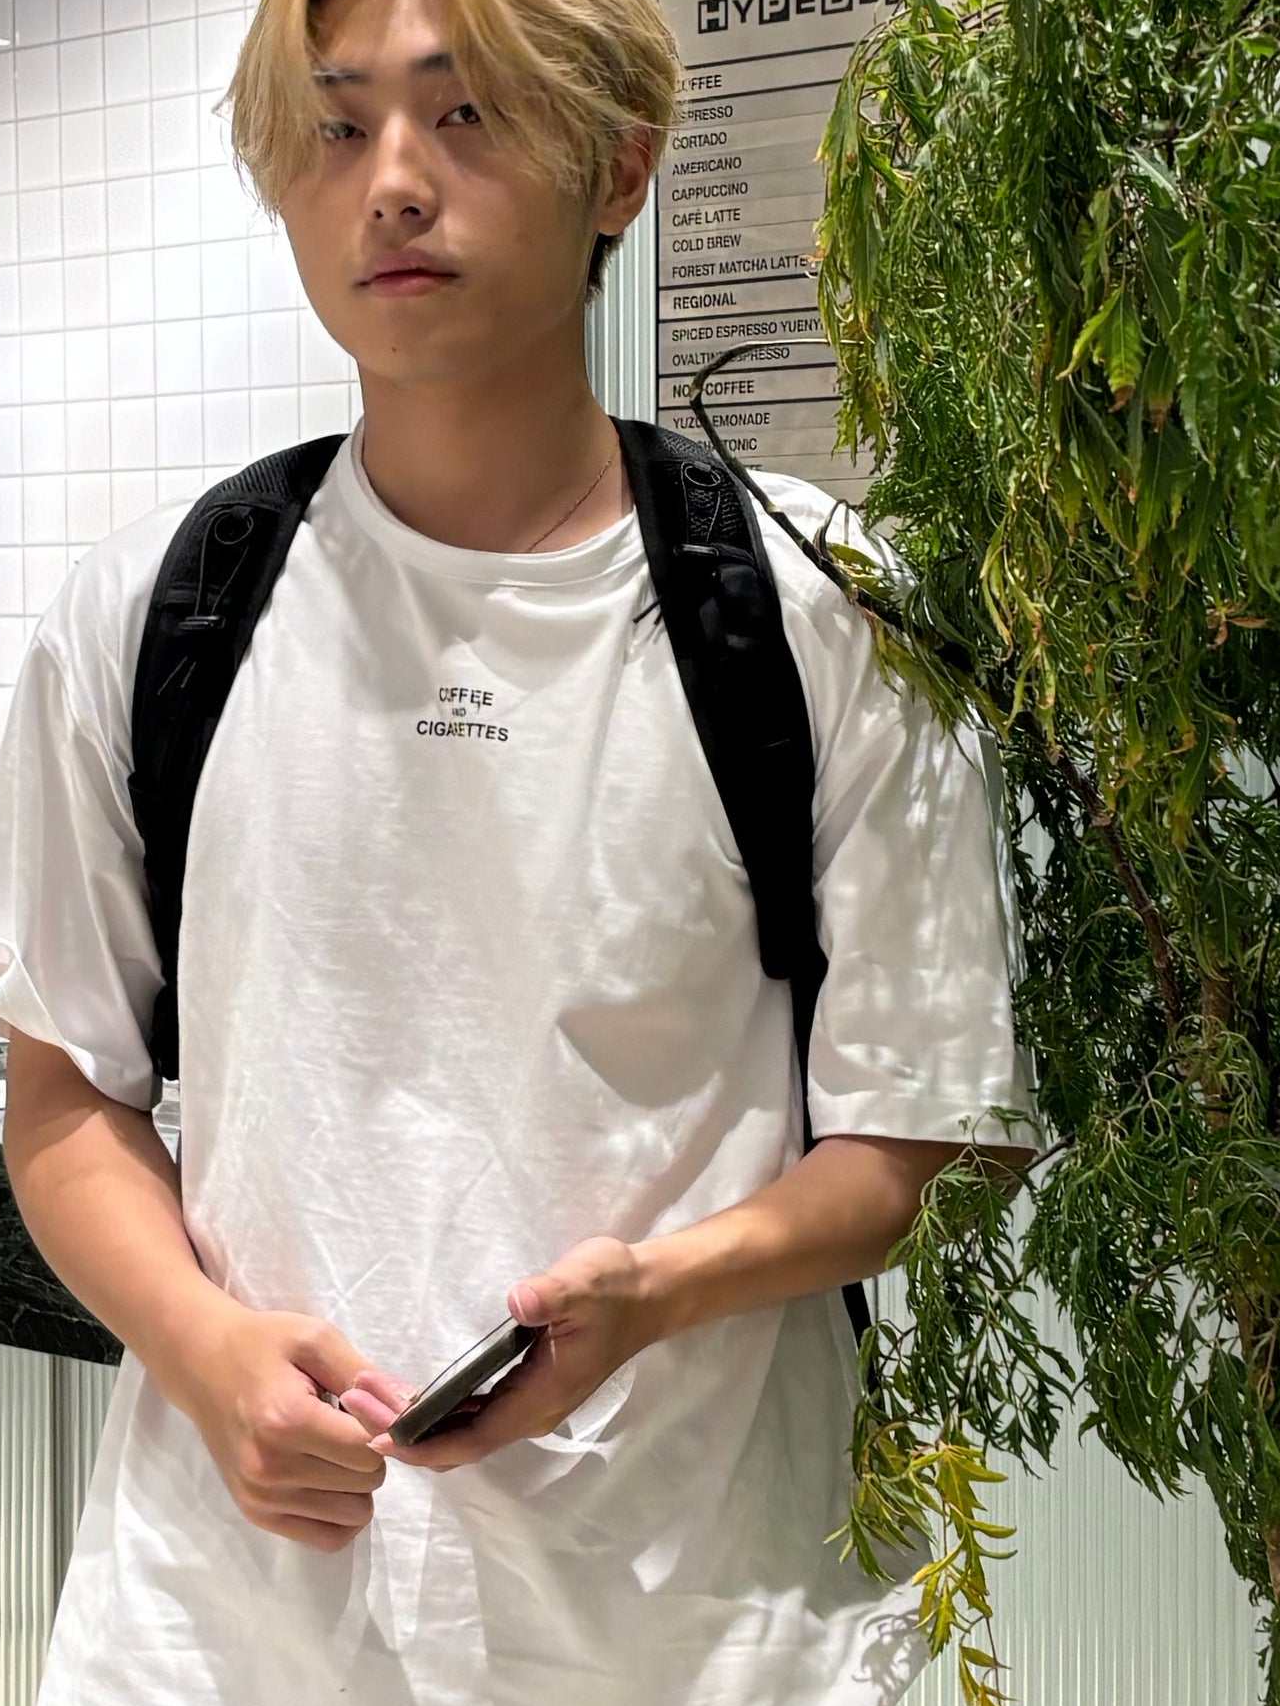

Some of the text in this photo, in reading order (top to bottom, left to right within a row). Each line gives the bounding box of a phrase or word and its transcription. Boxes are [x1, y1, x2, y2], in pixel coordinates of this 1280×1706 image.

[676, 74, 722, 92] OFFEE
[672, 131, 728, 150] CORTADO
[672, 156, 742, 176] AMERICANO
[672, 181, 748, 201] CAPPUCCINO
[672, 208, 741, 227] CAFÉ LATTE
[672, 234, 741, 253] COLD BREW
[672, 254, 807, 278] FOREST MATCHA LATTE
[673, 291, 737, 310] REGIONAL
[672, 327, 713, 341] SPICED
[716, 322, 777, 338] ESPRESSO
[672, 351, 721, 366] OVALTIN
[713, 412, 770, 427] EMONADE
